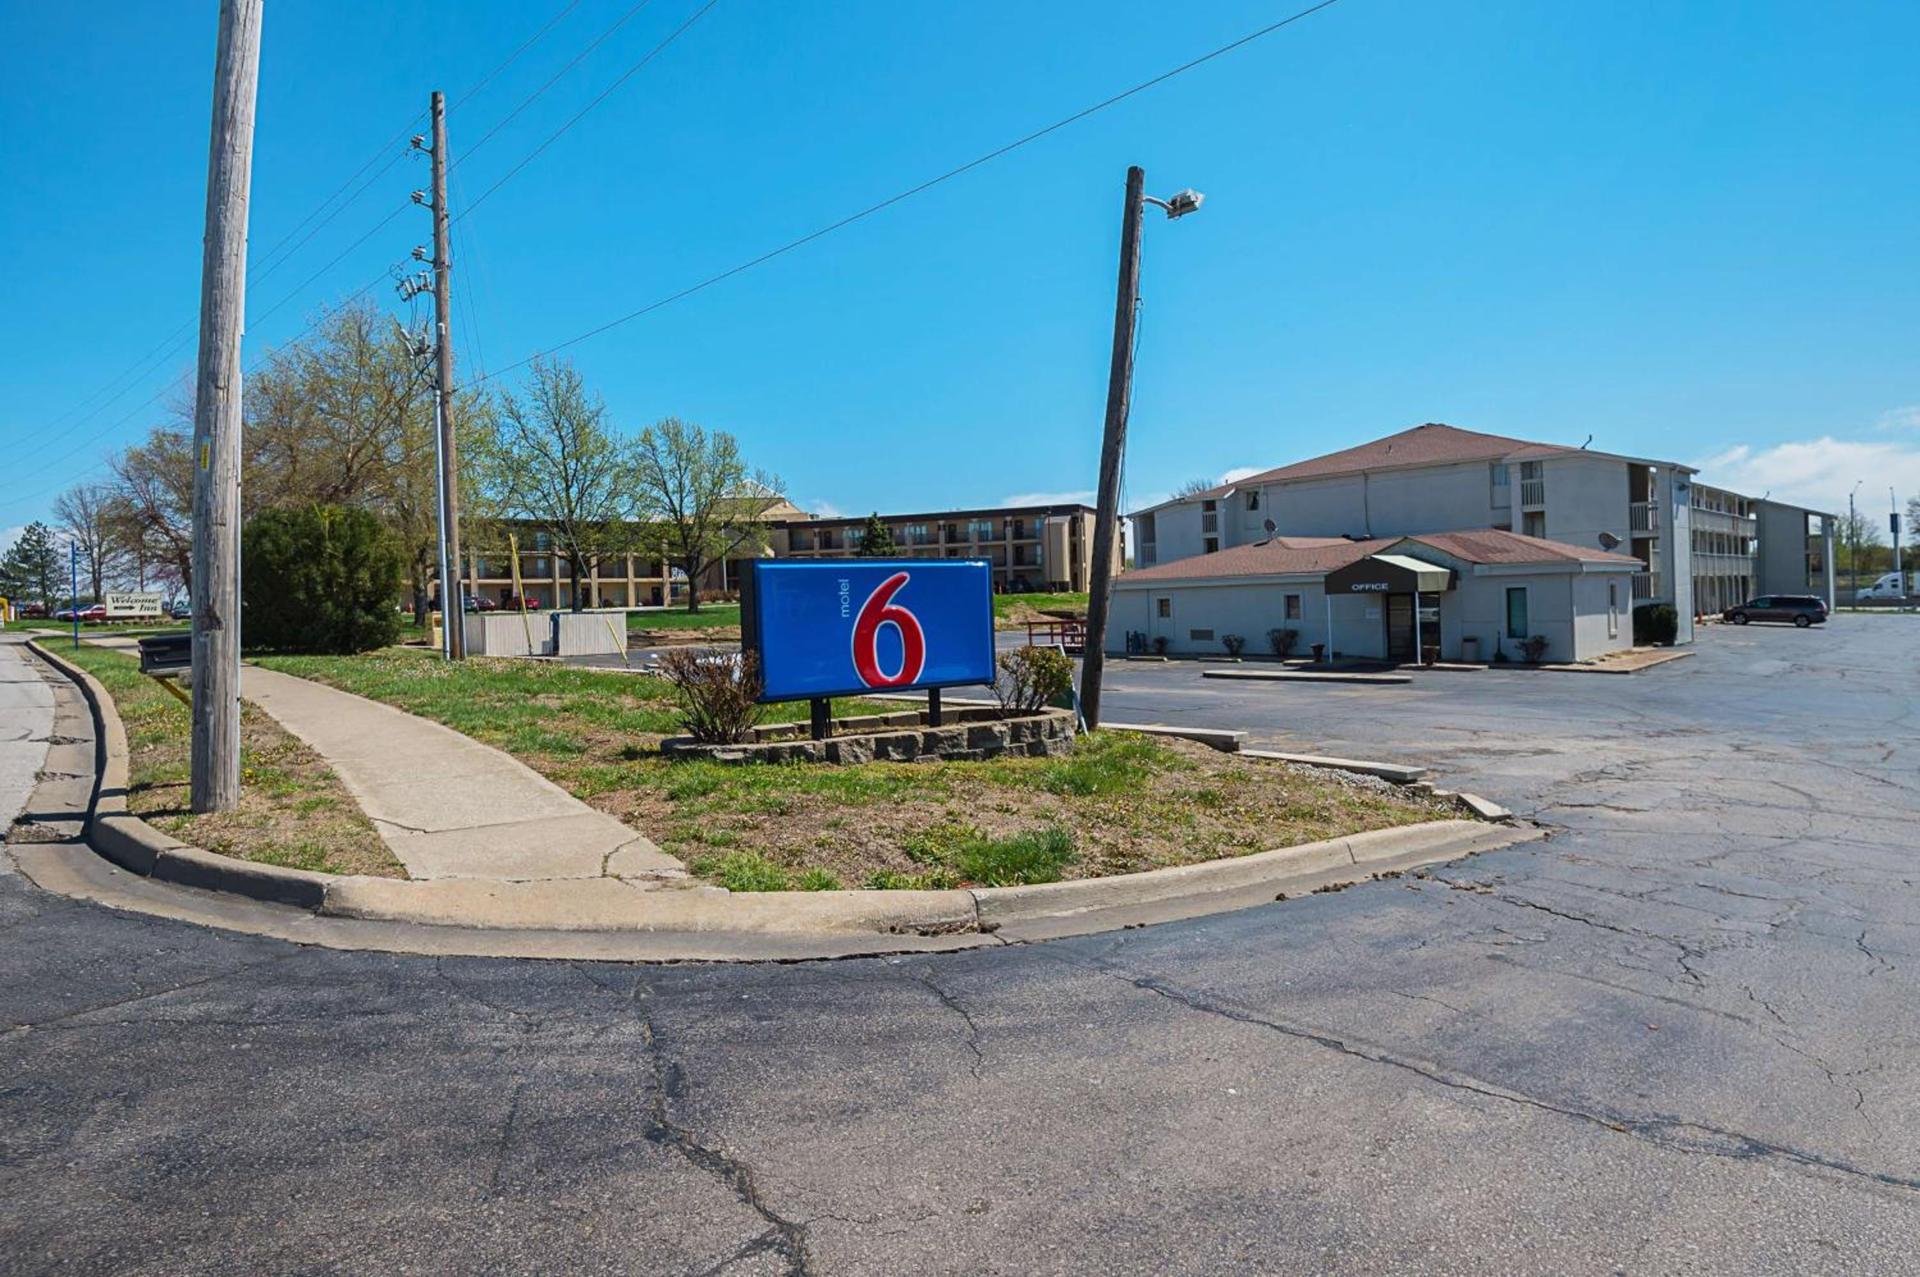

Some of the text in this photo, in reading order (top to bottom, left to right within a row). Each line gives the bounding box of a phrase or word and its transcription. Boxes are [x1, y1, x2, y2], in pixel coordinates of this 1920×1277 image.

[1351, 582, 1389, 591] OFFICE
[111, 595, 158, 604] Welcome
[838, 579, 850, 618] motel
[139, 604, 158, 612] Inn
[851, 571, 926, 688] 6
